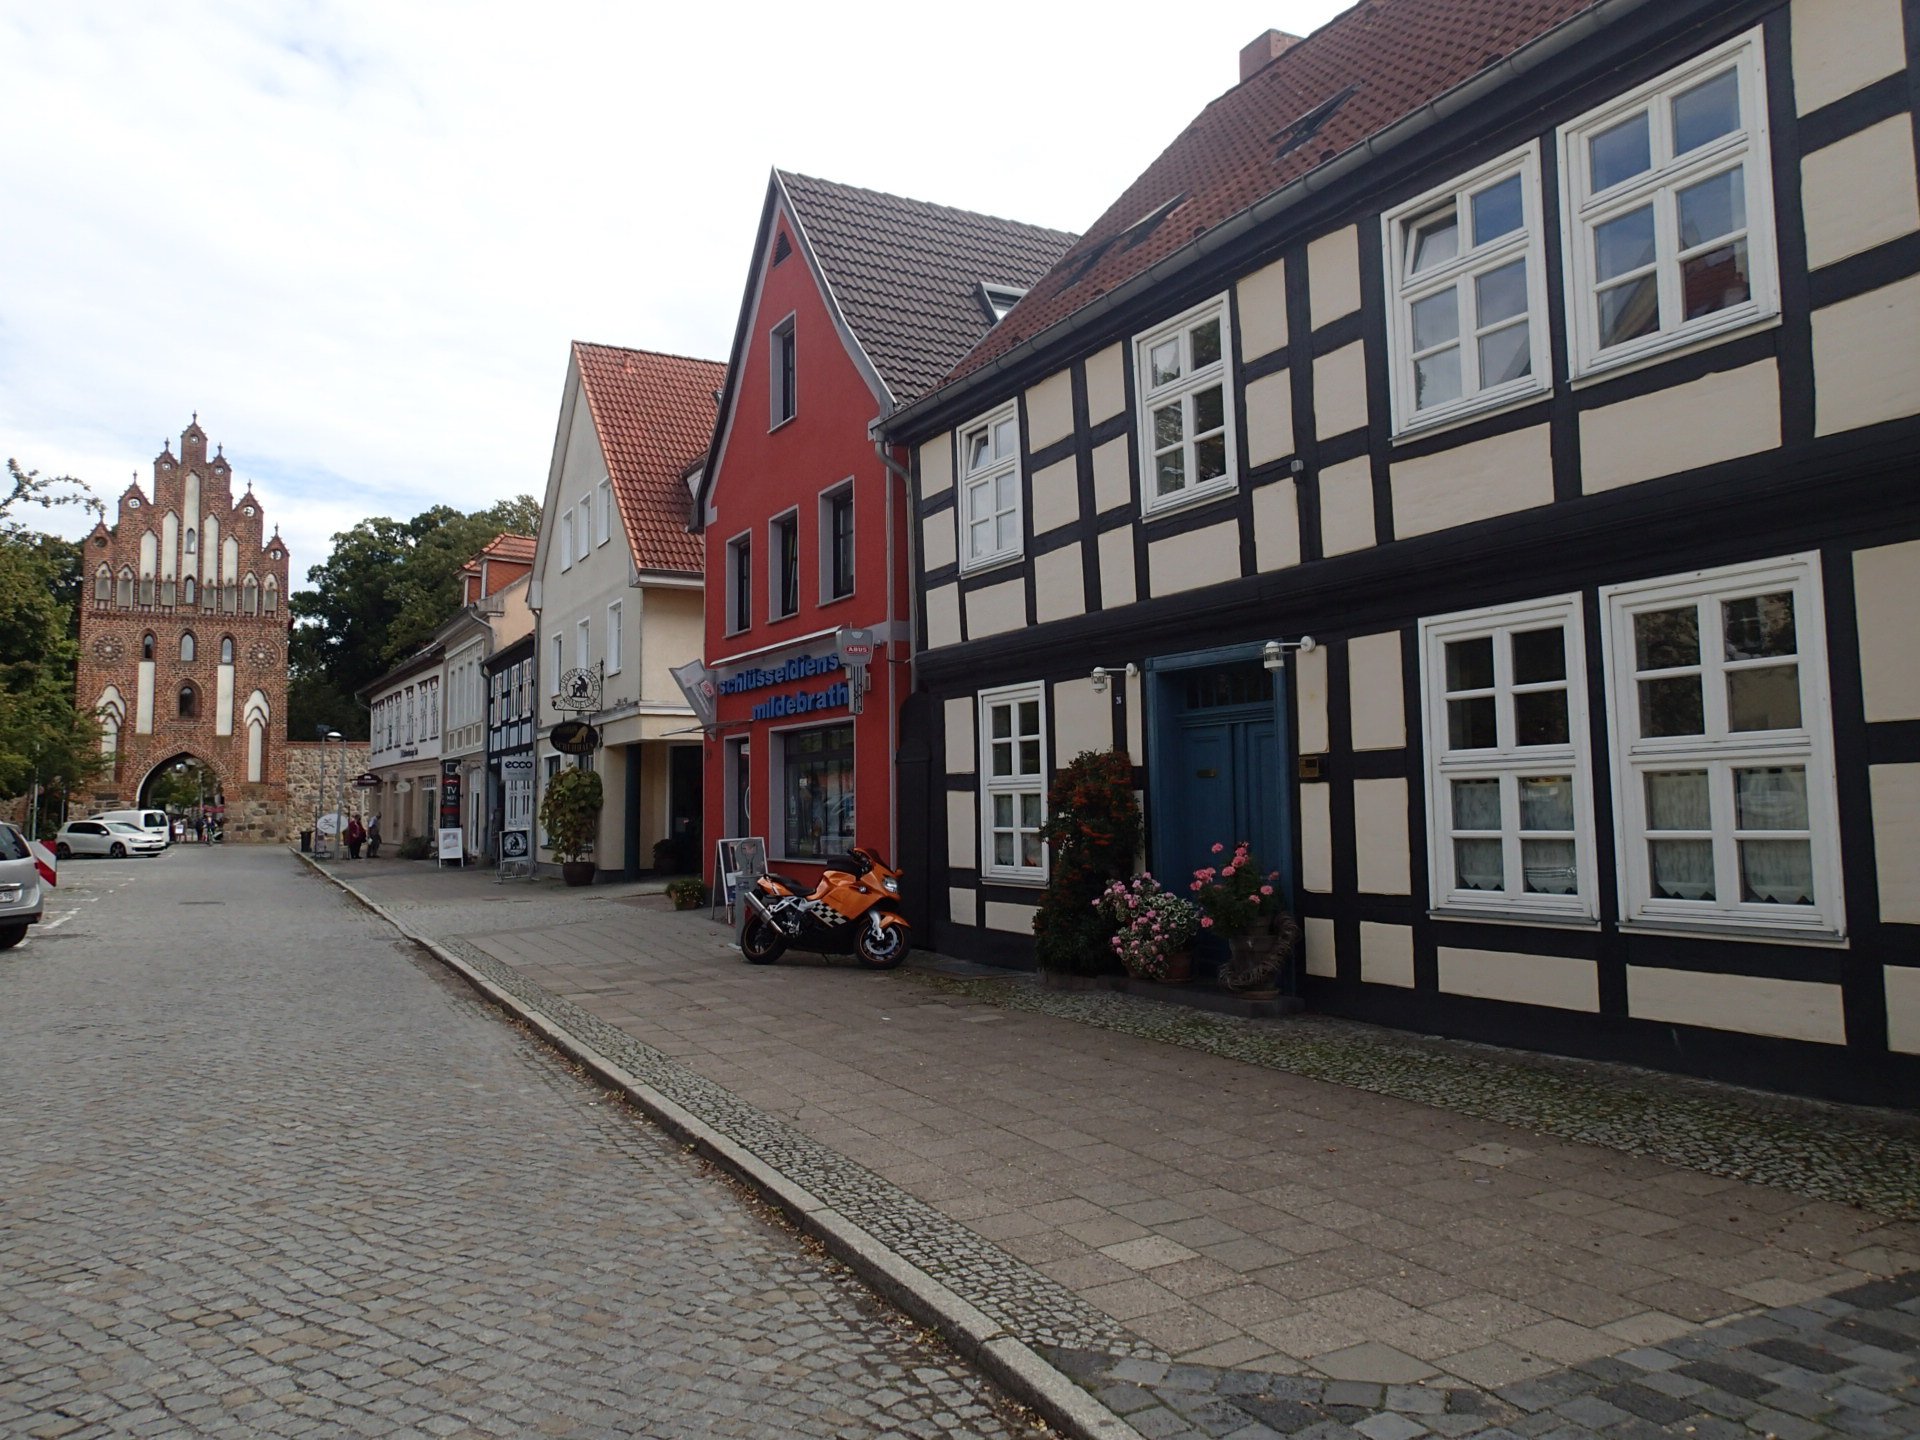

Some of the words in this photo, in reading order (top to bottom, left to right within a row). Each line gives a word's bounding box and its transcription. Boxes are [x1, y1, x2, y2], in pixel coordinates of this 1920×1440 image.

[719, 653, 844, 695] schlüsseldiens
[752, 682, 849, 720] mildebrath
[505, 761, 533, 769] ecco
[447, 786, 457, 794] TV
